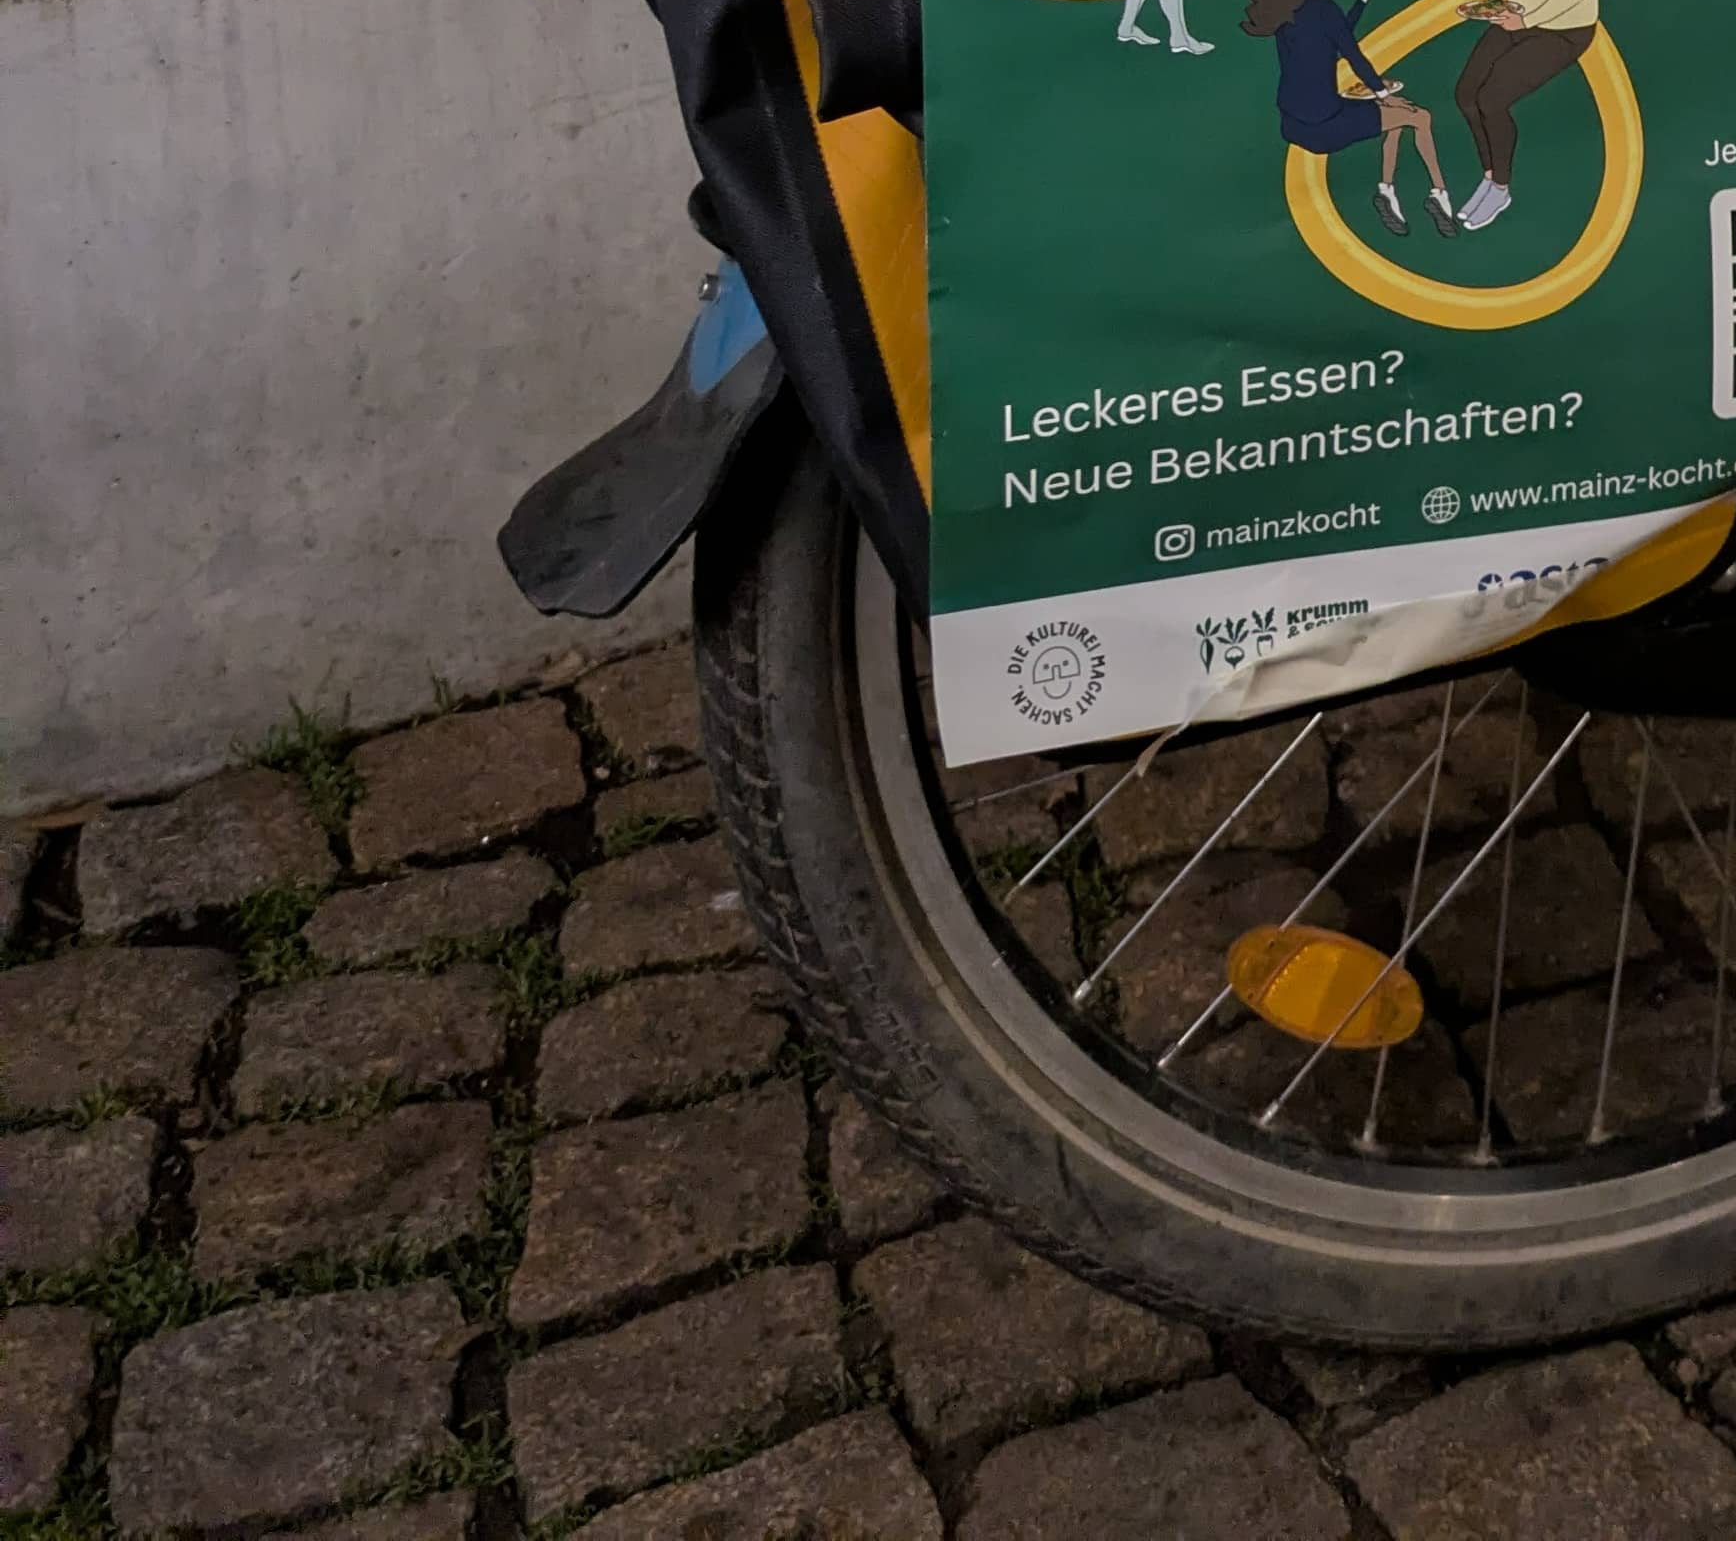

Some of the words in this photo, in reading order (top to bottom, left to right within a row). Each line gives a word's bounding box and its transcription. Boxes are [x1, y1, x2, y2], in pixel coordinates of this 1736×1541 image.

[1003, 381, 1223, 442] Leckeres
[1240, 349, 1406, 408] Essen?
[1004, 458, 1133, 508] Neue
[1150, 391, 1583, 485] Bekanntschaften?
[1206, 501, 1382, 549] mainzkocht
[1007, 645, 1030, 675] DIE
[1026, 621, 1101, 653] KULTUREI
[1011, 684, 1073, 726] SACHEN.
[1076, 654, 1106, 716] MACHT
